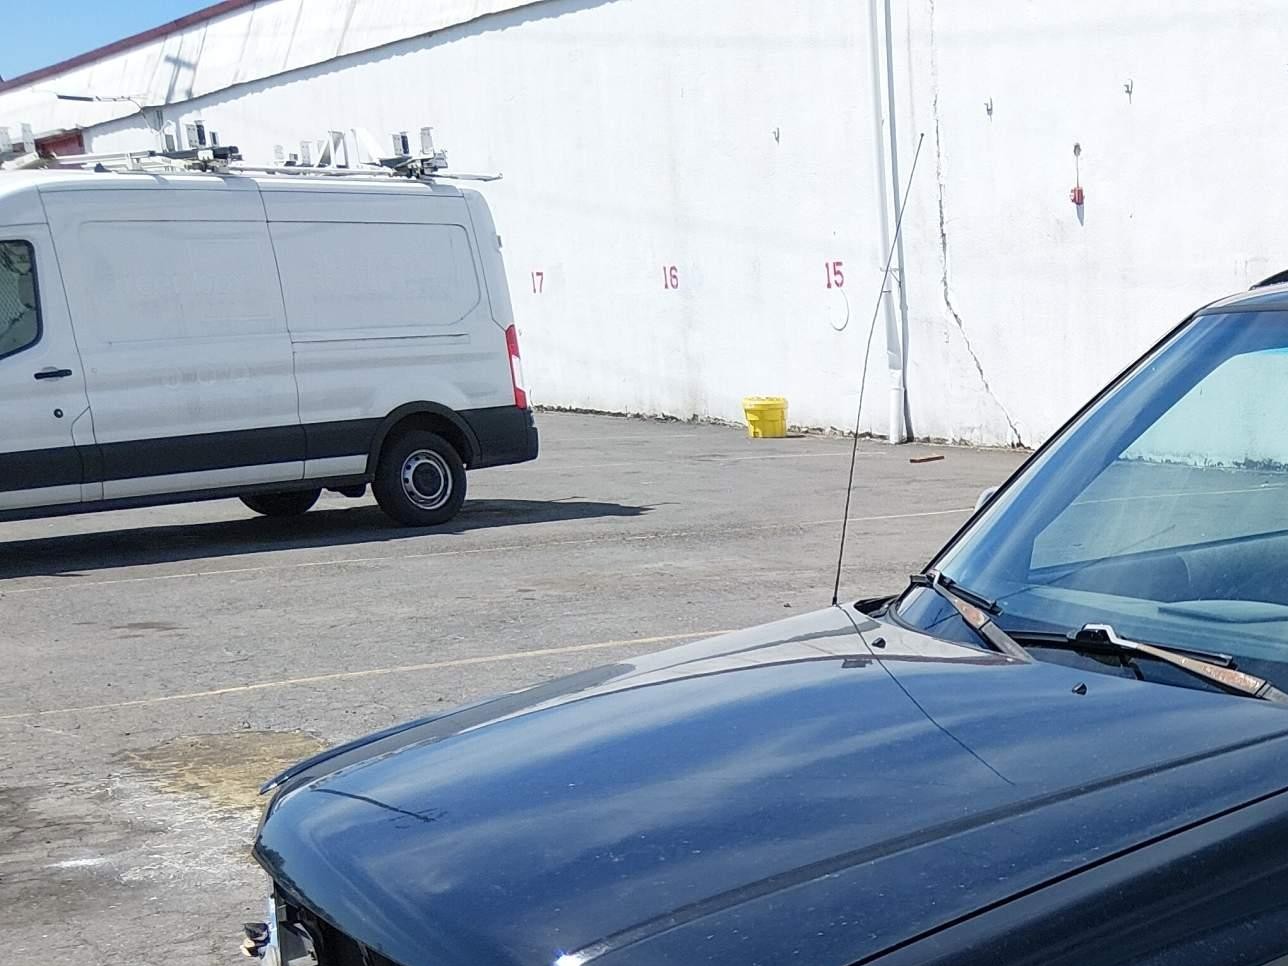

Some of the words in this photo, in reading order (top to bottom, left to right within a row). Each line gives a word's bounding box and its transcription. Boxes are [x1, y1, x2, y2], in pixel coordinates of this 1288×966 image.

[531, 271, 544, 294] 17
[662, 265, 679, 290] 16
[824, 261, 845, 289] 15
